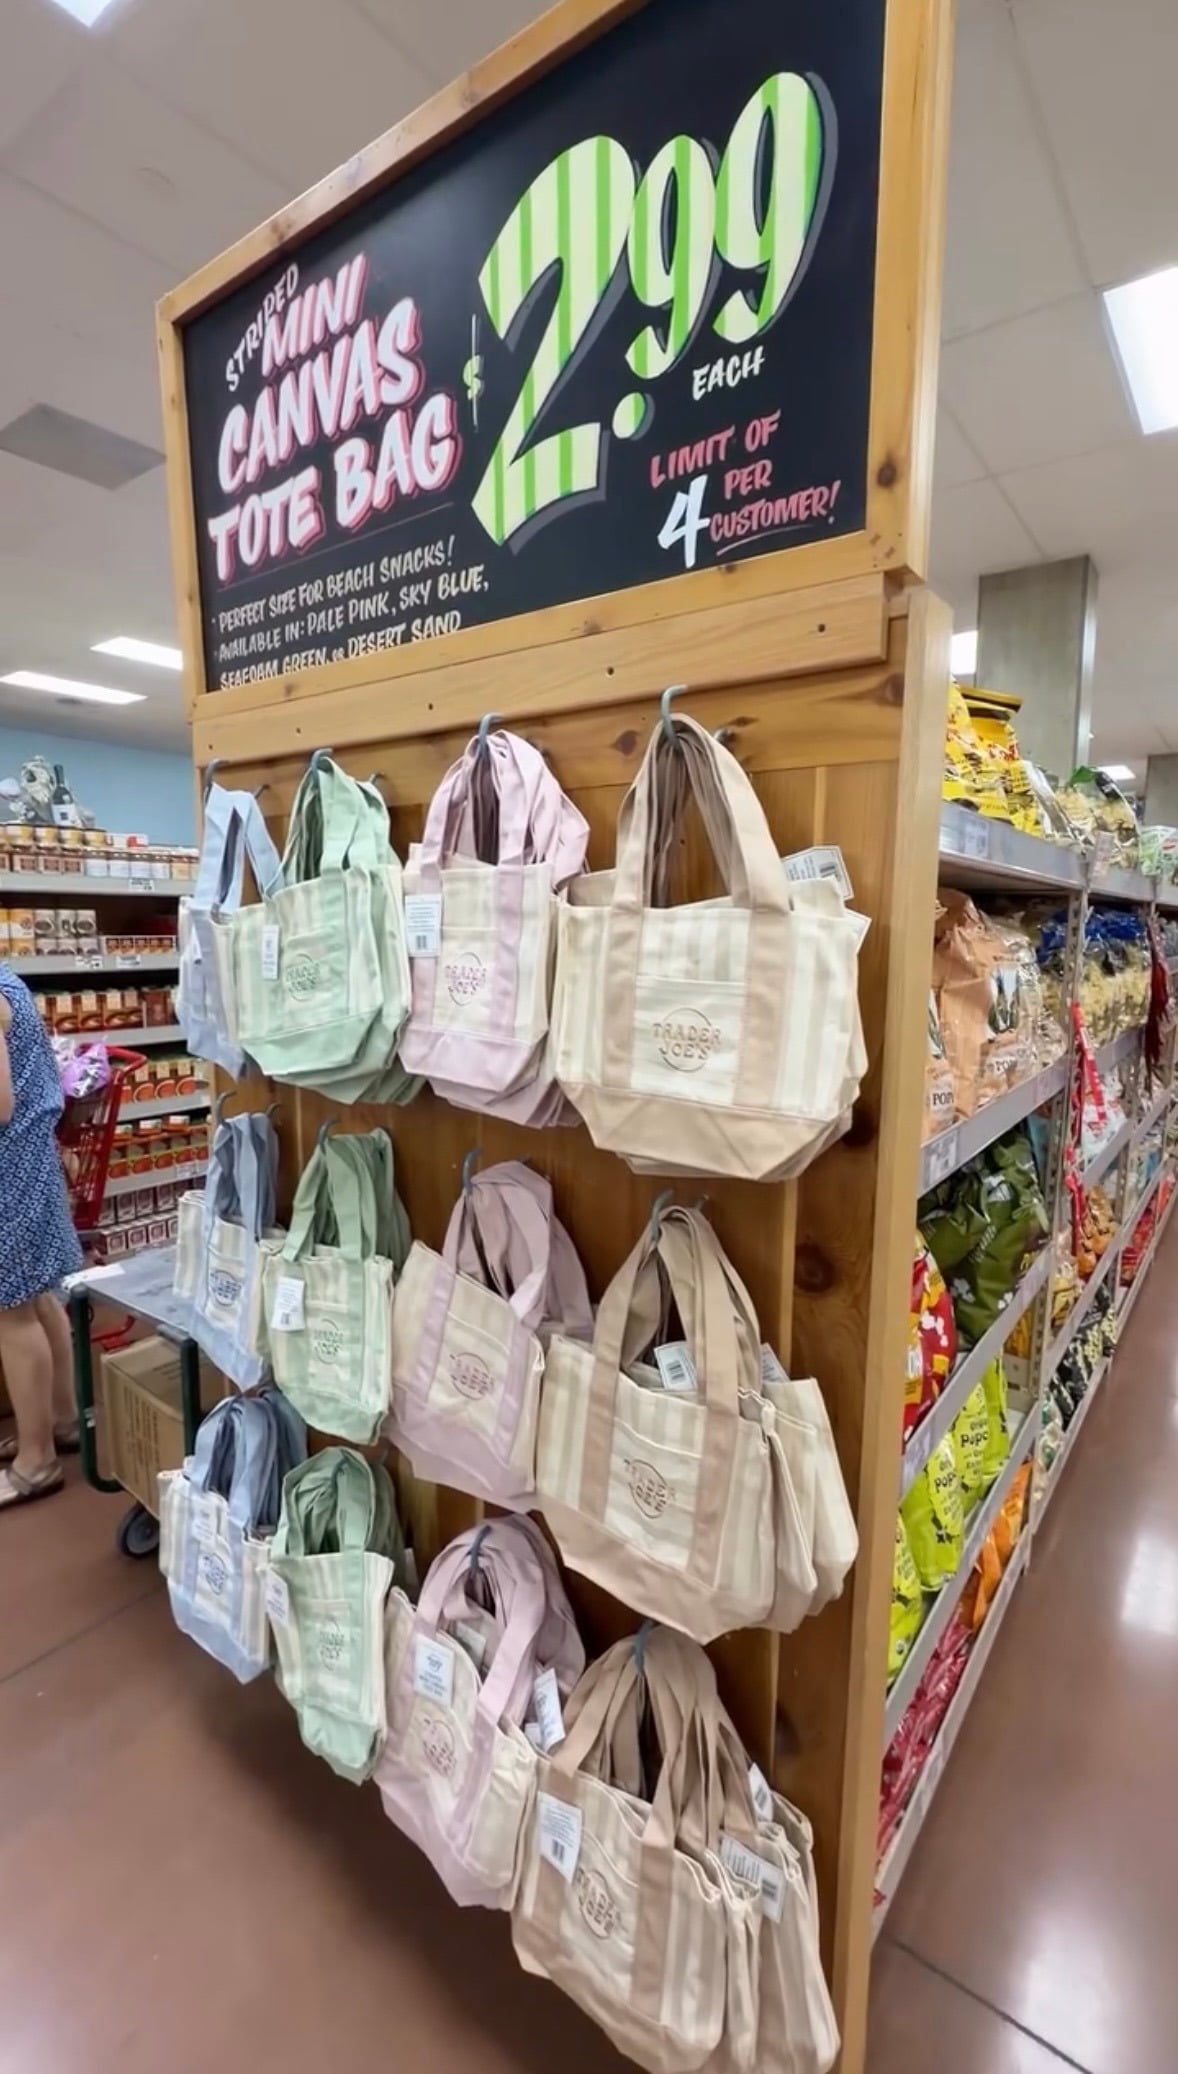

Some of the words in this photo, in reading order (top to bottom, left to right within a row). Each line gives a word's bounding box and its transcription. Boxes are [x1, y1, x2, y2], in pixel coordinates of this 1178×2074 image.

[225, 263, 300, 392] STRIPED
[261, 252, 367, 377] MINI
[218, 297, 424, 494] CANVAS
[692, 346, 765, 400] EACH
[208, 466, 325, 582] TOTE
[334, 393, 459, 531] BAG
[650, 426, 735, 489] LIMIT
[745, 409, 781, 453] OF
[656, 474, 710, 568] 4
[725, 458, 772, 500] PER
[710, 480, 841, 541] CUSTOMER!
[218, 599, 266, 633] PERFECT
[269, 588, 297, 619] SIZE
[299, 579, 324, 607] FOR
[326, 562, 375, 599] BEACH
[380, 535, 455, 583] SNACKS!
[218, 631, 282, 663] AVAILABLE
[285, 622, 304, 643] IN:
[307, 604, 344, 635] PALE
[349, 591, 397, 625] PINK,
[399, 581, 432, 608] SKY
[437, 564, 489, 601] BLUE,
[219, 659, 279, 691] SEAFOAM
[347, 623, 407, 659] DESERT
[411, 610, 461, 643] SAND
[653, 1022, 721, 1045] TRADER
[659, 1042, 711, 1061] JOE'S
